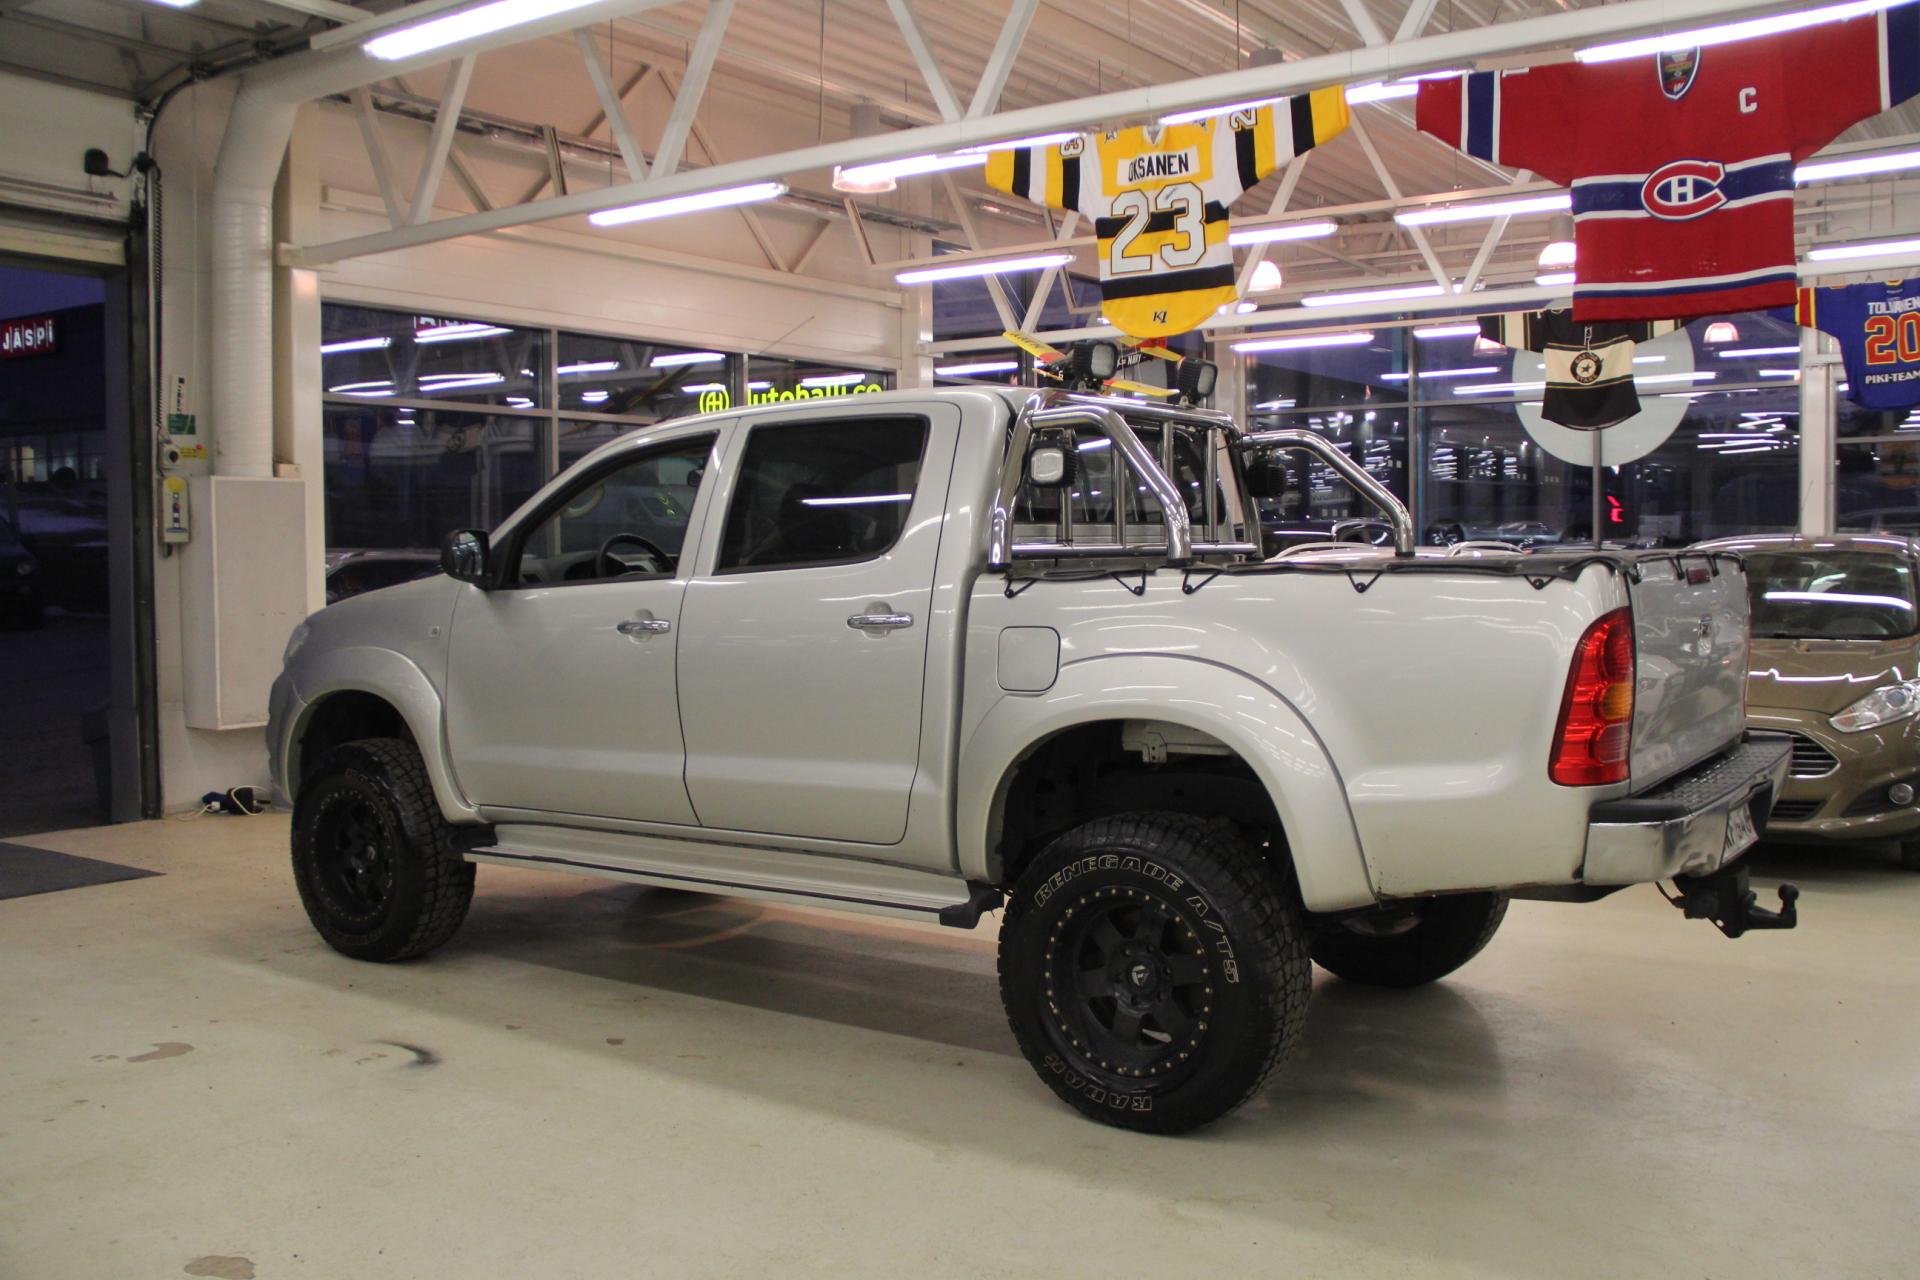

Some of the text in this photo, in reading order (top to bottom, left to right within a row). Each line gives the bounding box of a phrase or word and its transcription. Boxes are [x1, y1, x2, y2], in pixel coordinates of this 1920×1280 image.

[1739, 86, 1758, 114] C
[1110, 181, 1207, 275] 23
[1864, 312, 1920, 365] 20
[1033, 853, 1185, 908] RENEGADE
